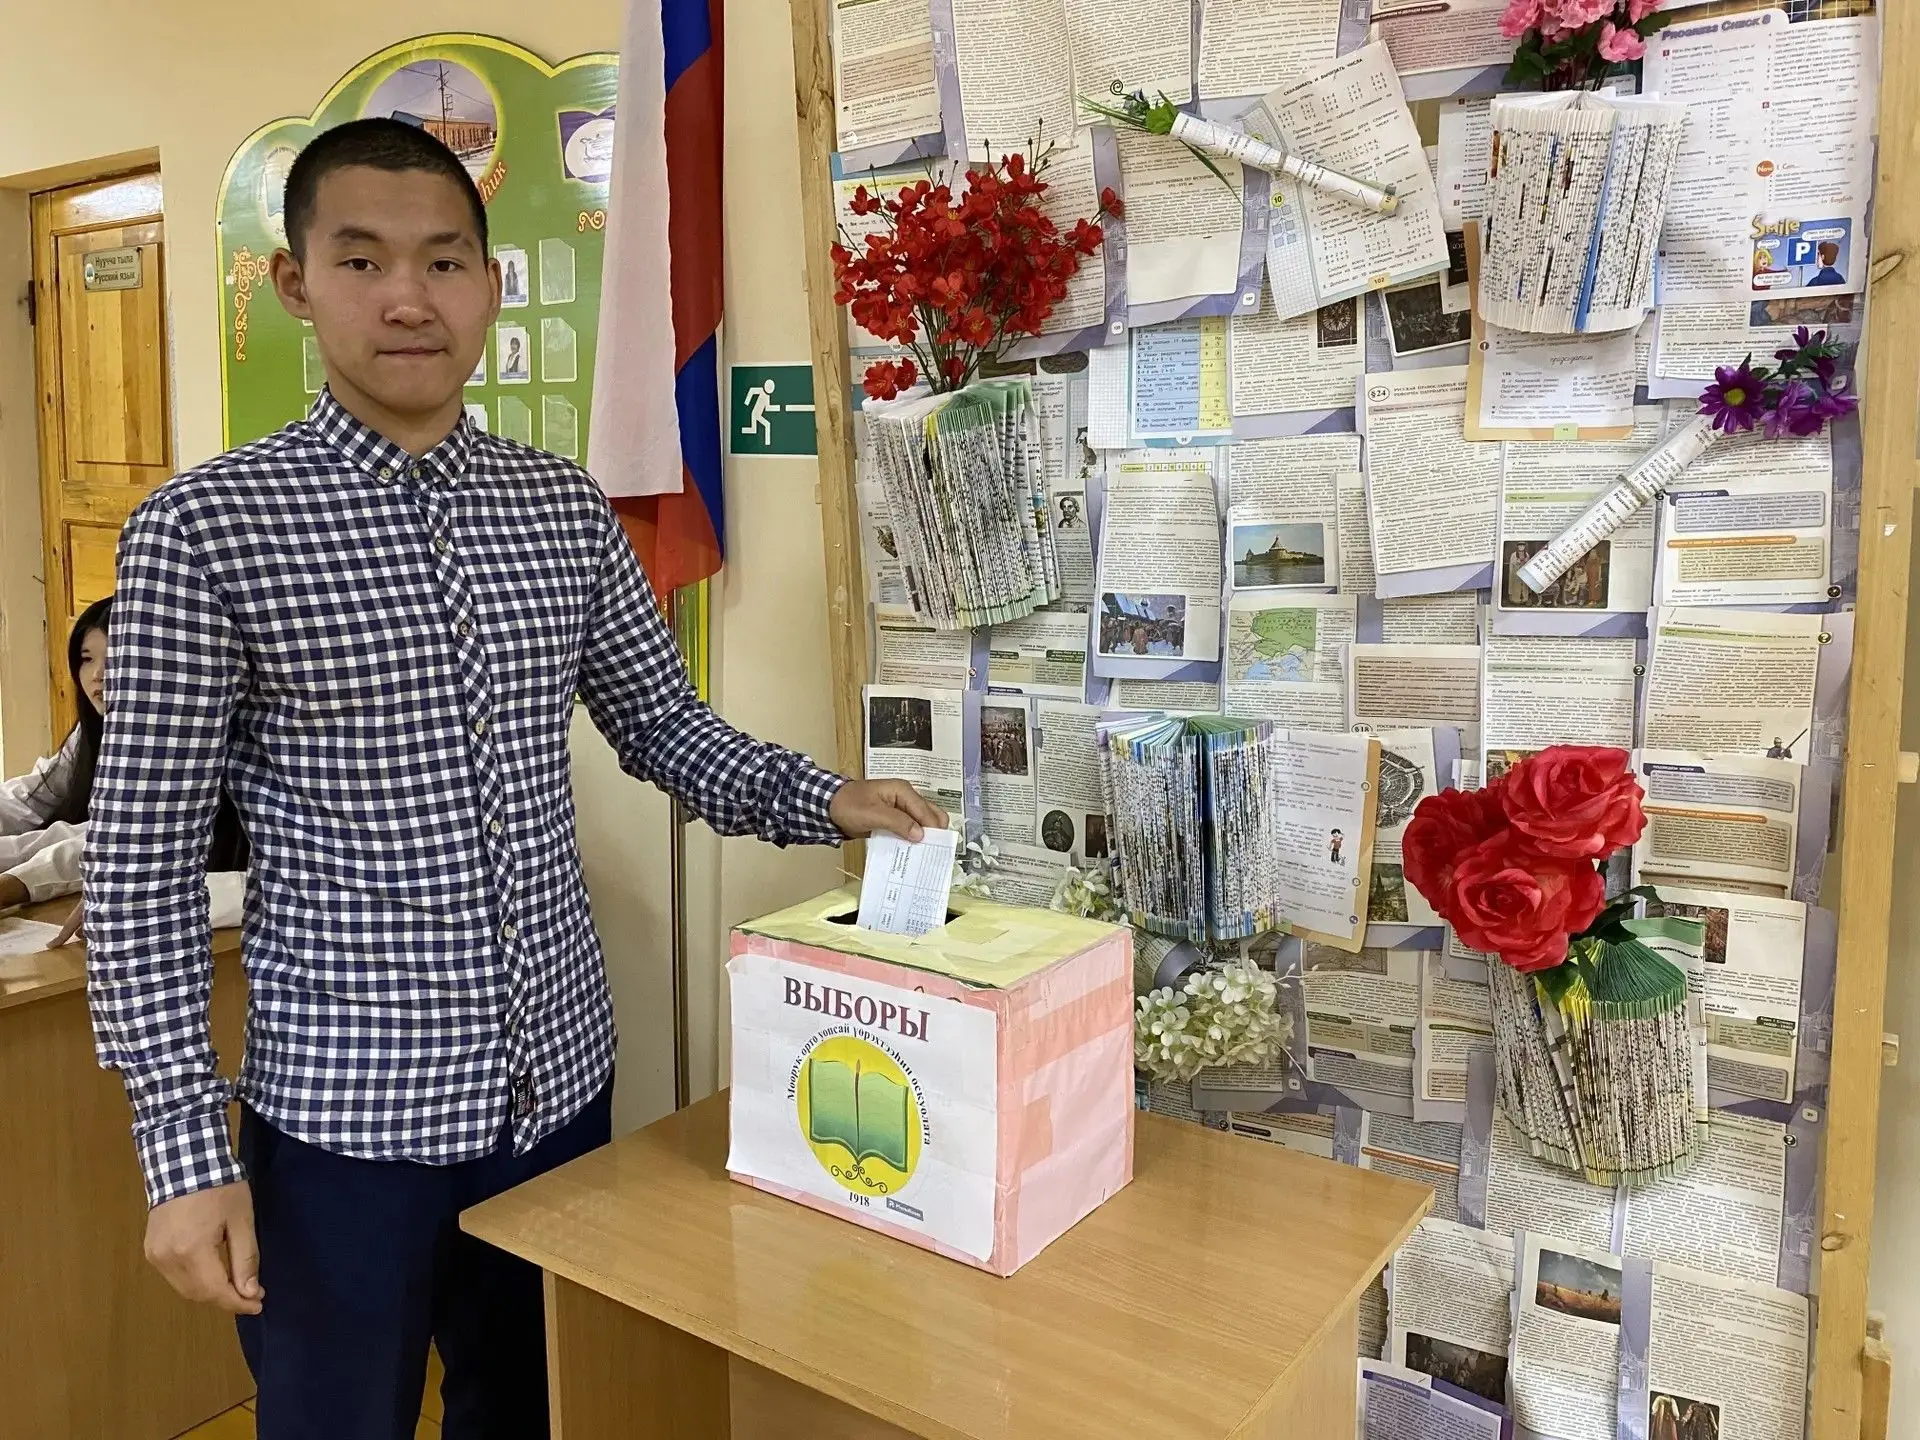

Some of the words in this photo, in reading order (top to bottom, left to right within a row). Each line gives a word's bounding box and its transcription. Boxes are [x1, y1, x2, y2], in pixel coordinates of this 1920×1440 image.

[1274, 196, 1282, 204] 10
[1750, 214, 1799, 239] Smile
[1795, 242, 1810, 261] P
[95, 271, 118, 284] Русский
[120, 272, 134, 280] язык
[1371, 390, 1386, 398] §24
[784, 976, 931, 1042] ВЫБОРЫ
[849, 1192, 870, 1207] 1918
